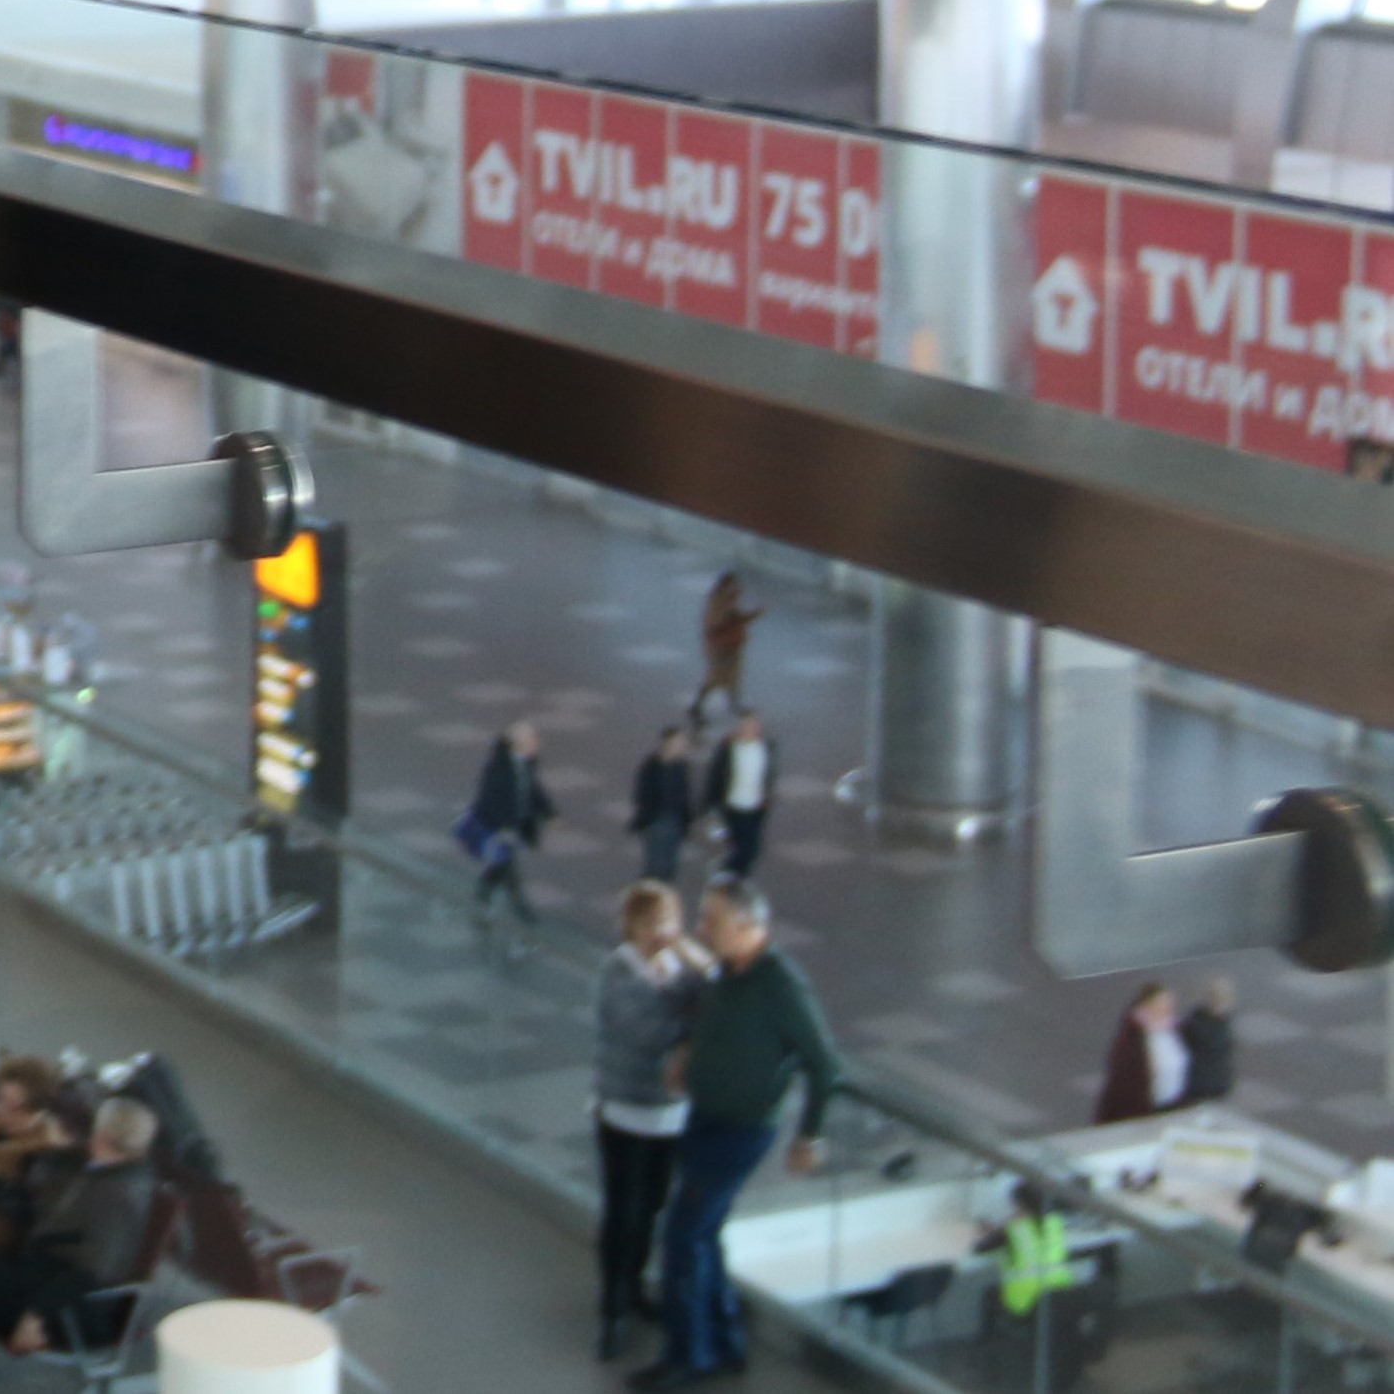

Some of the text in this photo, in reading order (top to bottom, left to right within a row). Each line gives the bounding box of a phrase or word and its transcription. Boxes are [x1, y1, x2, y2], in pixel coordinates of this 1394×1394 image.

[532, 129, 737, 229] TVIL.RU
[763, 172, 827, 248] 75
[1137, 246, 1394, 371] TVIL.R
[1134, 343, 1267, 417] ОТЕЛИ
